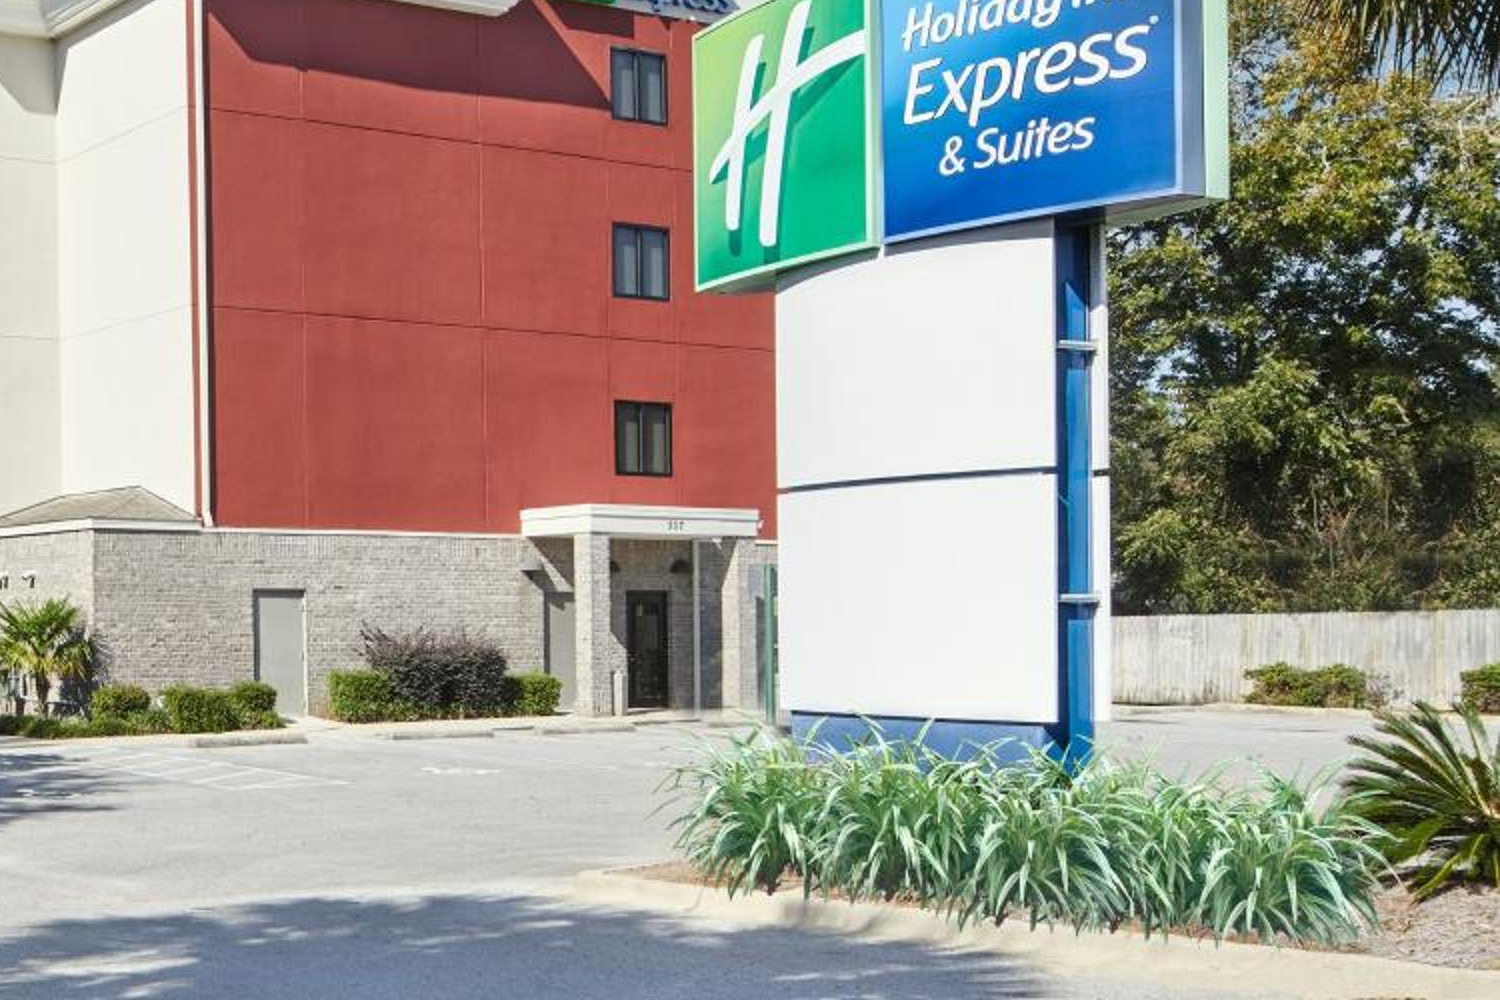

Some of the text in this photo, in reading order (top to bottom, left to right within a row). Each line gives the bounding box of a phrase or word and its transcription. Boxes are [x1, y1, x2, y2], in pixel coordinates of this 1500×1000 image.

[903, 22, 1151, 127] Express
[939, 116, 1096, 176] & Suites
